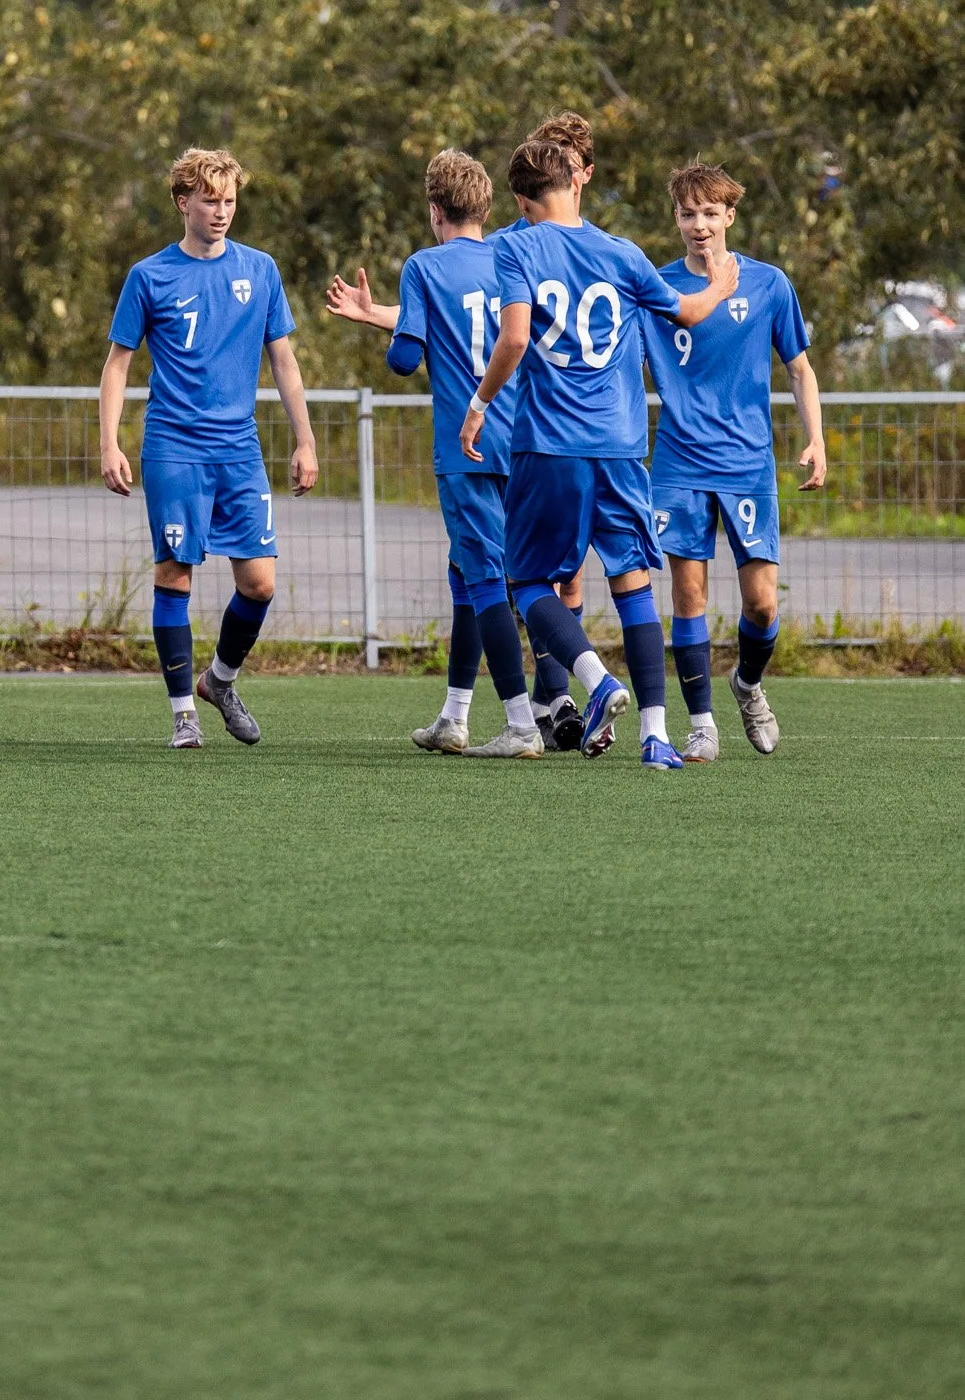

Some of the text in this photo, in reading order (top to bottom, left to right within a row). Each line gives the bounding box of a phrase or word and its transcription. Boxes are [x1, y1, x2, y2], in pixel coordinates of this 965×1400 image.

[183, 311, 199, 349] 7
[463, 290, 501, 377] 1
[536, 280, 622, 369] 20
[674, 329, 692, 366] 9
[261, 494, 272, 531] 7
[738, 499, 756, 535] 9
